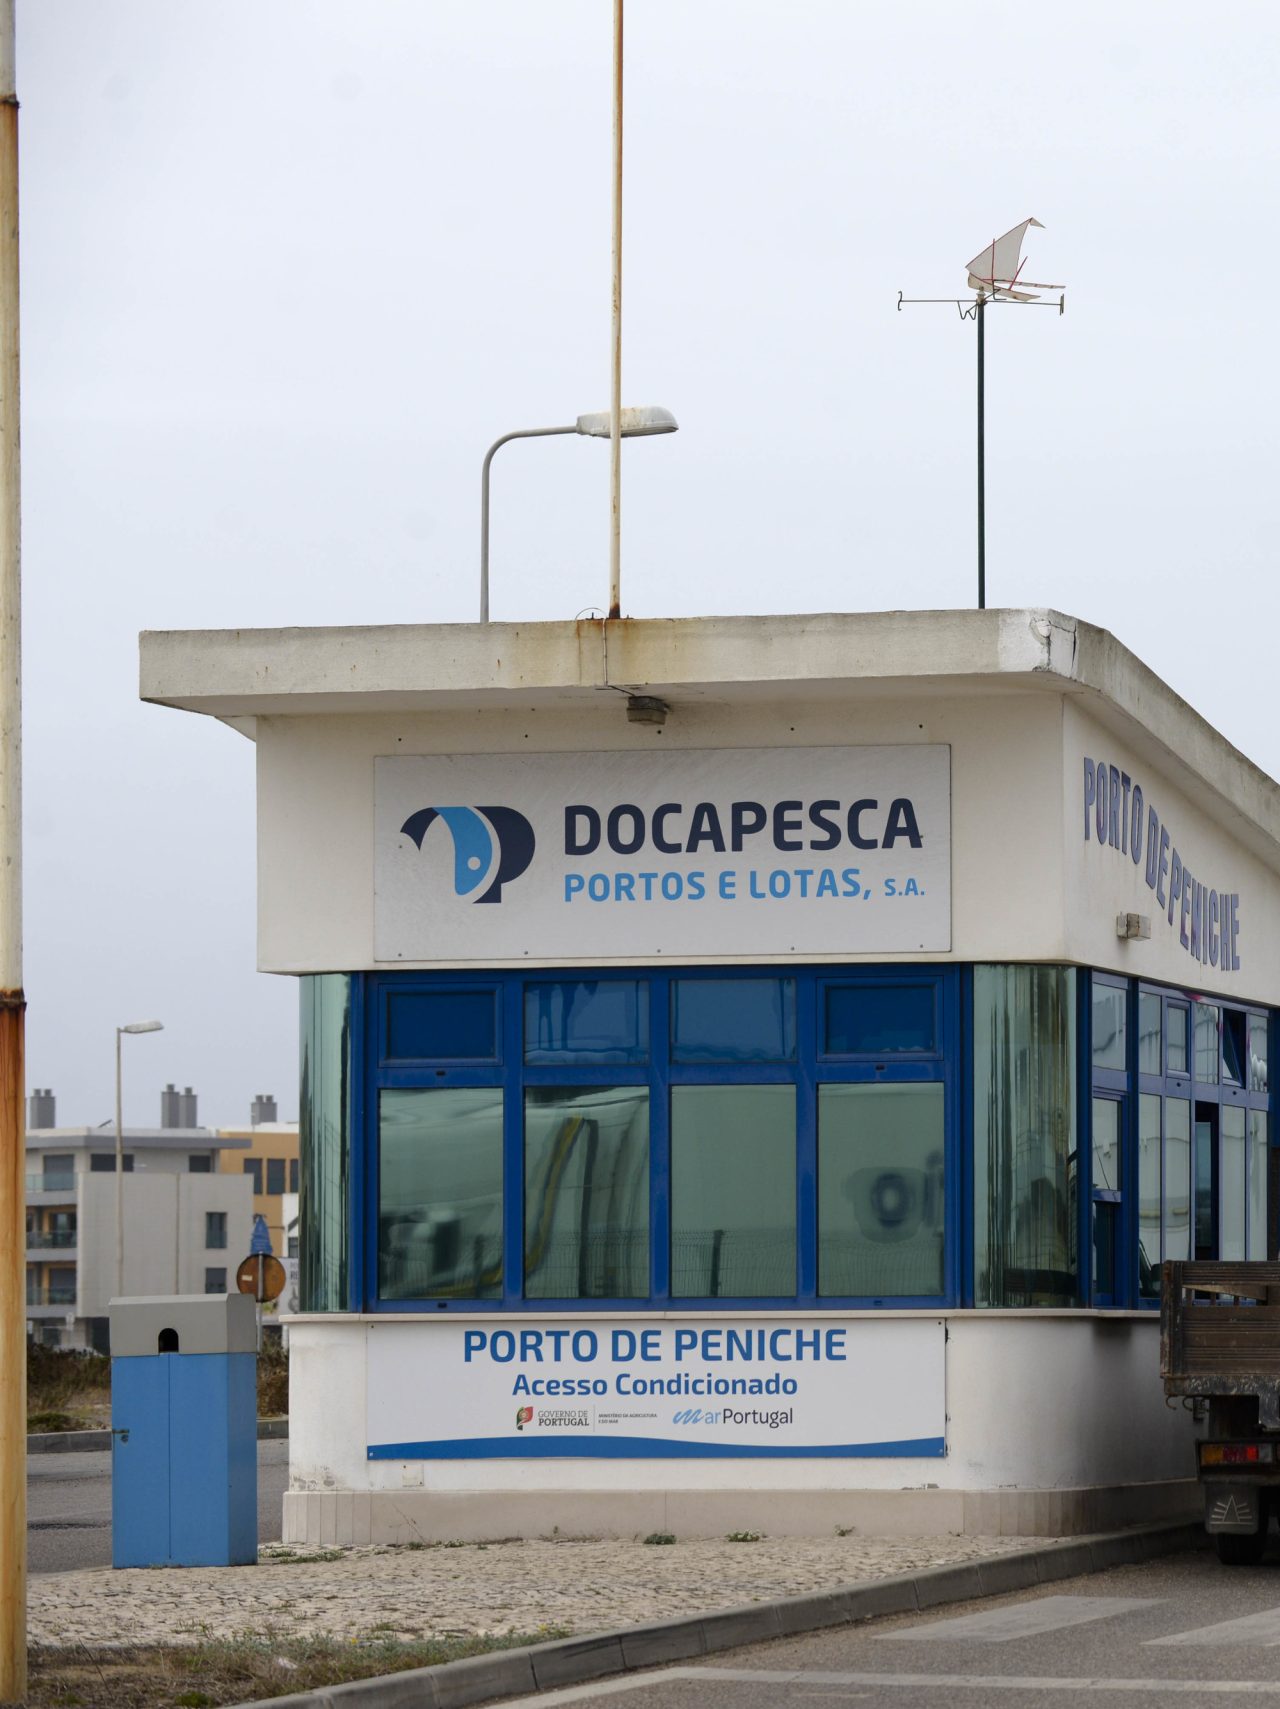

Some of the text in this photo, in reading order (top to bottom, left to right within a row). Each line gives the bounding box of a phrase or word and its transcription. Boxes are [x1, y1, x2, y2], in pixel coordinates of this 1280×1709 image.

[564, 797, 923, 856] DOCAPESCA
[1083, 756, 1241, 972] PORTO DE PENICHE
[564, 868, 926, 903] PORTOS E LOTAS, S.A.
[463, 1328, 848, 1363] PORTO DE PENICHE
[511, 1372, 798, 1397] Acesso Condicionado
[537, 1409, 588, 1418] GOVERNO DE
[538, 1417, 590, 1427] PORTUGAL
